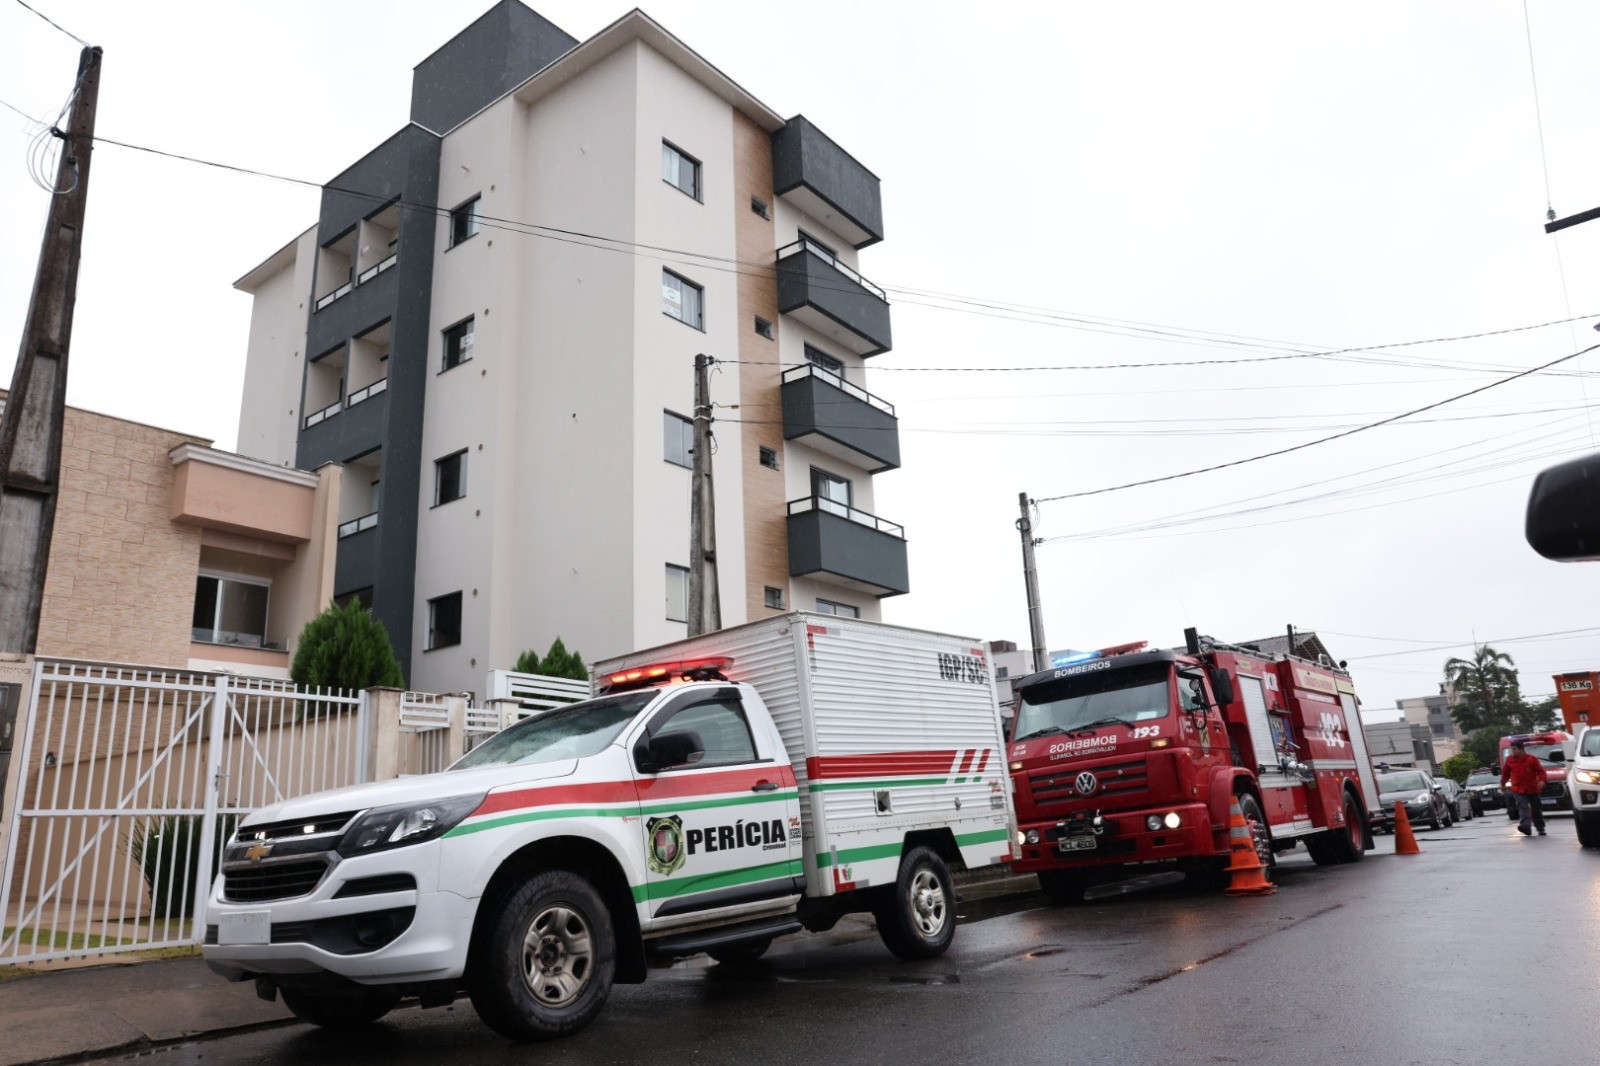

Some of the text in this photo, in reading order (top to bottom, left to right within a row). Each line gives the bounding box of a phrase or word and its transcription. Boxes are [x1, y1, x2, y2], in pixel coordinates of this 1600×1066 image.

[937, 652, 984, 684] IGP/SC
[1054, 660, 1111, 678] BOMBEIROS
[1579, 681, 1592, 690] Kg
[1133, 725, 1160, 739] 193
[686, 819, 786, 855] PERÍCIA
[762, 842, 787, 851] Criminal
